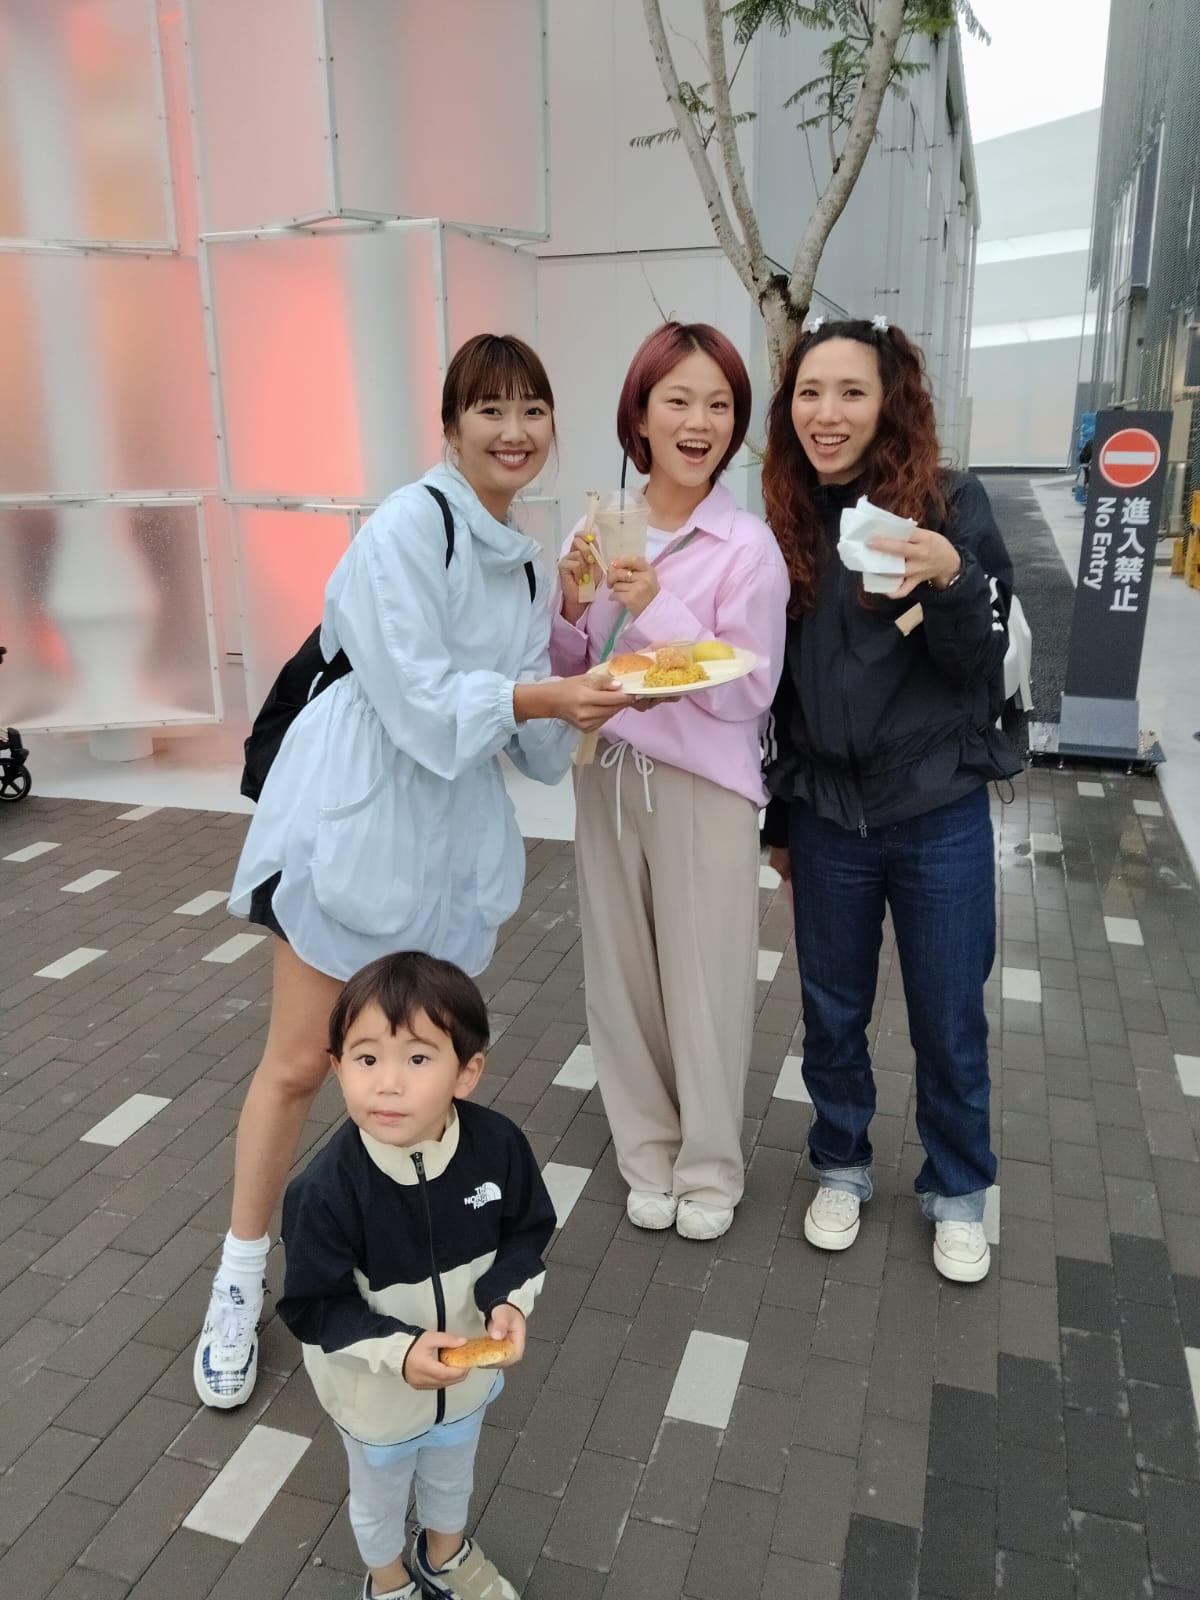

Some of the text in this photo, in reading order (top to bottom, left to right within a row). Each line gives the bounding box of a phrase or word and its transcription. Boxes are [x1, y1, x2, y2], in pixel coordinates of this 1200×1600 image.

[1083, 497, 1117, 590] No Entry
[1109, 497, 1151, 612] 進入禁止
